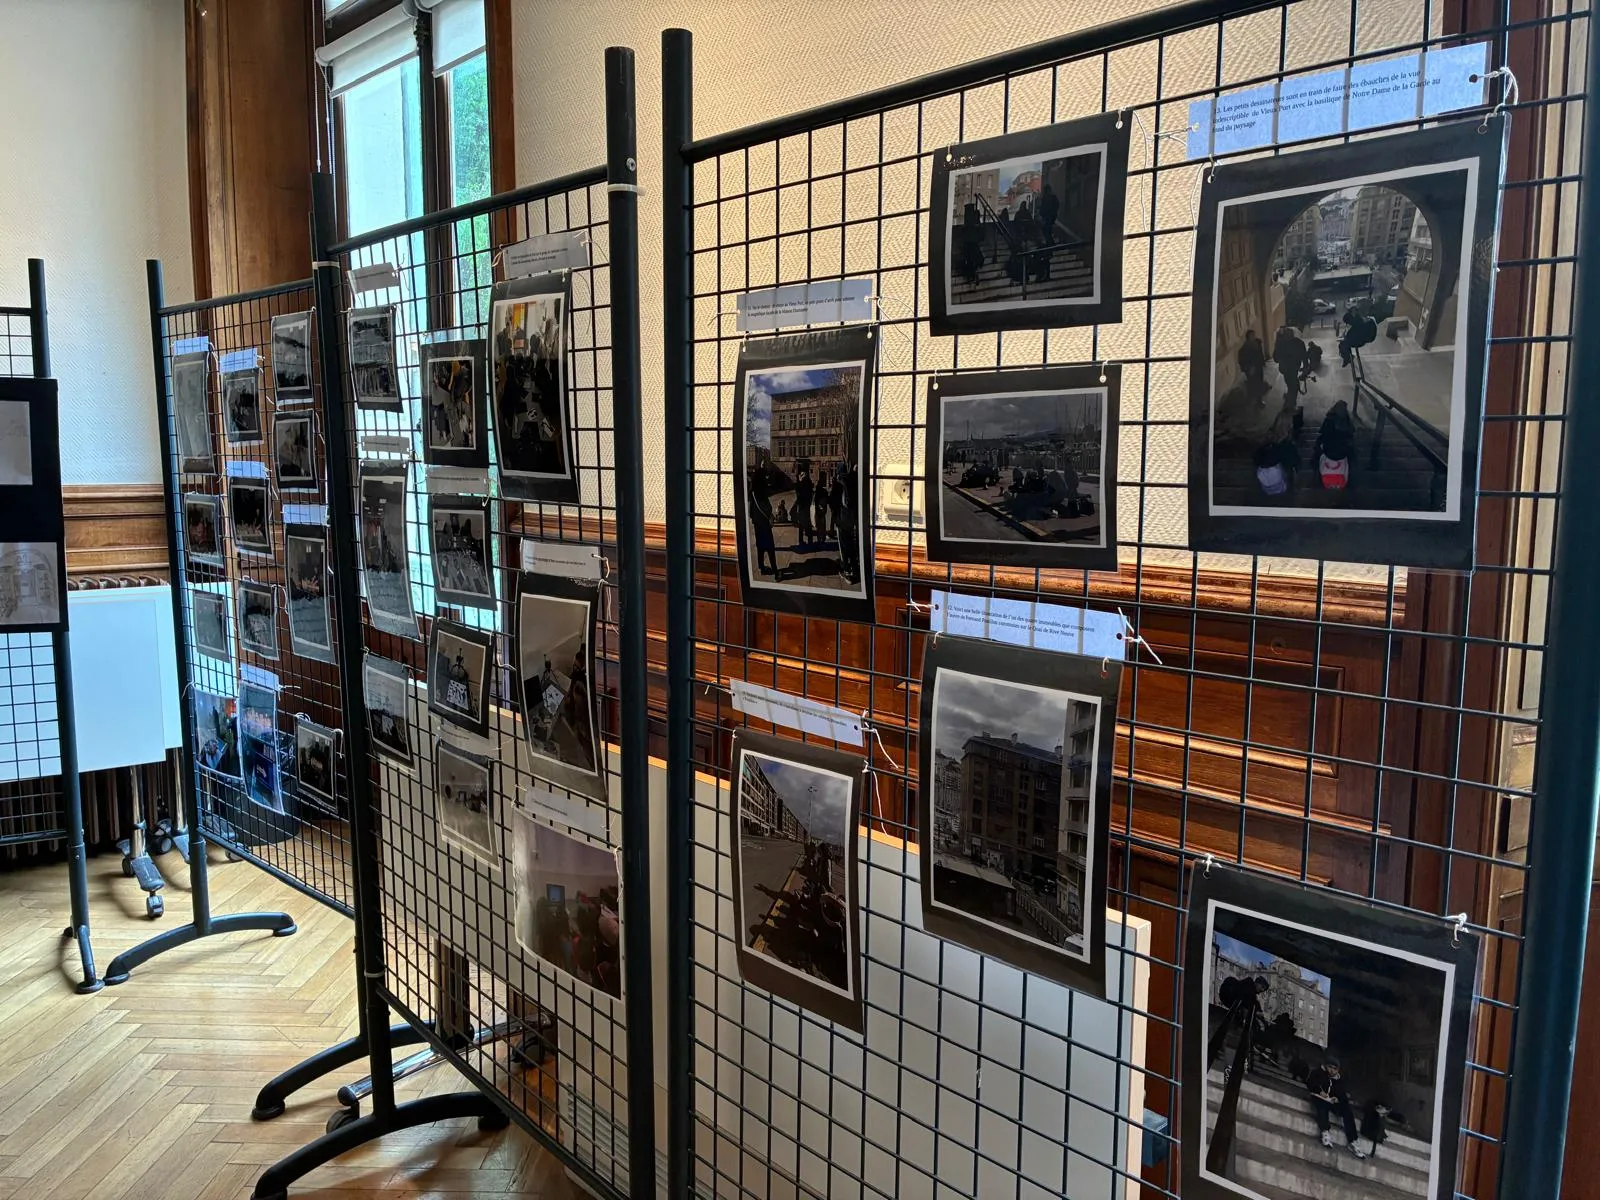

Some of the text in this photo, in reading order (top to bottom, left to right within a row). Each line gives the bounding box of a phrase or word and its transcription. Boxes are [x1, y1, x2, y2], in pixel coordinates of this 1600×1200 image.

[1234, 102, 1250, 112] petits
[1332, 84, 1347, 93] faire
[1348, 81, 1359, 89] des
[1360, 75, 1390, 88] ébauches
[1390, 73, 1399, 81] de
[1400, 71, 1407, 79] la
[1408, 70, 1421, 78] vue
[1291, 102, 1305, 110] avec
[1307, 98, 1313, 106] la
[1314, 95, 1342, 106] basilique
[1343, 92, 1350, 101] de
[1352, 91, 1371, 99] Notre
[1371, 86, 1391, 95] Dame
[1392, 84, 1401, 92] de
[1409, 78, 1431, 89] Garde
[1233, 121, 1256, 131] paysage
